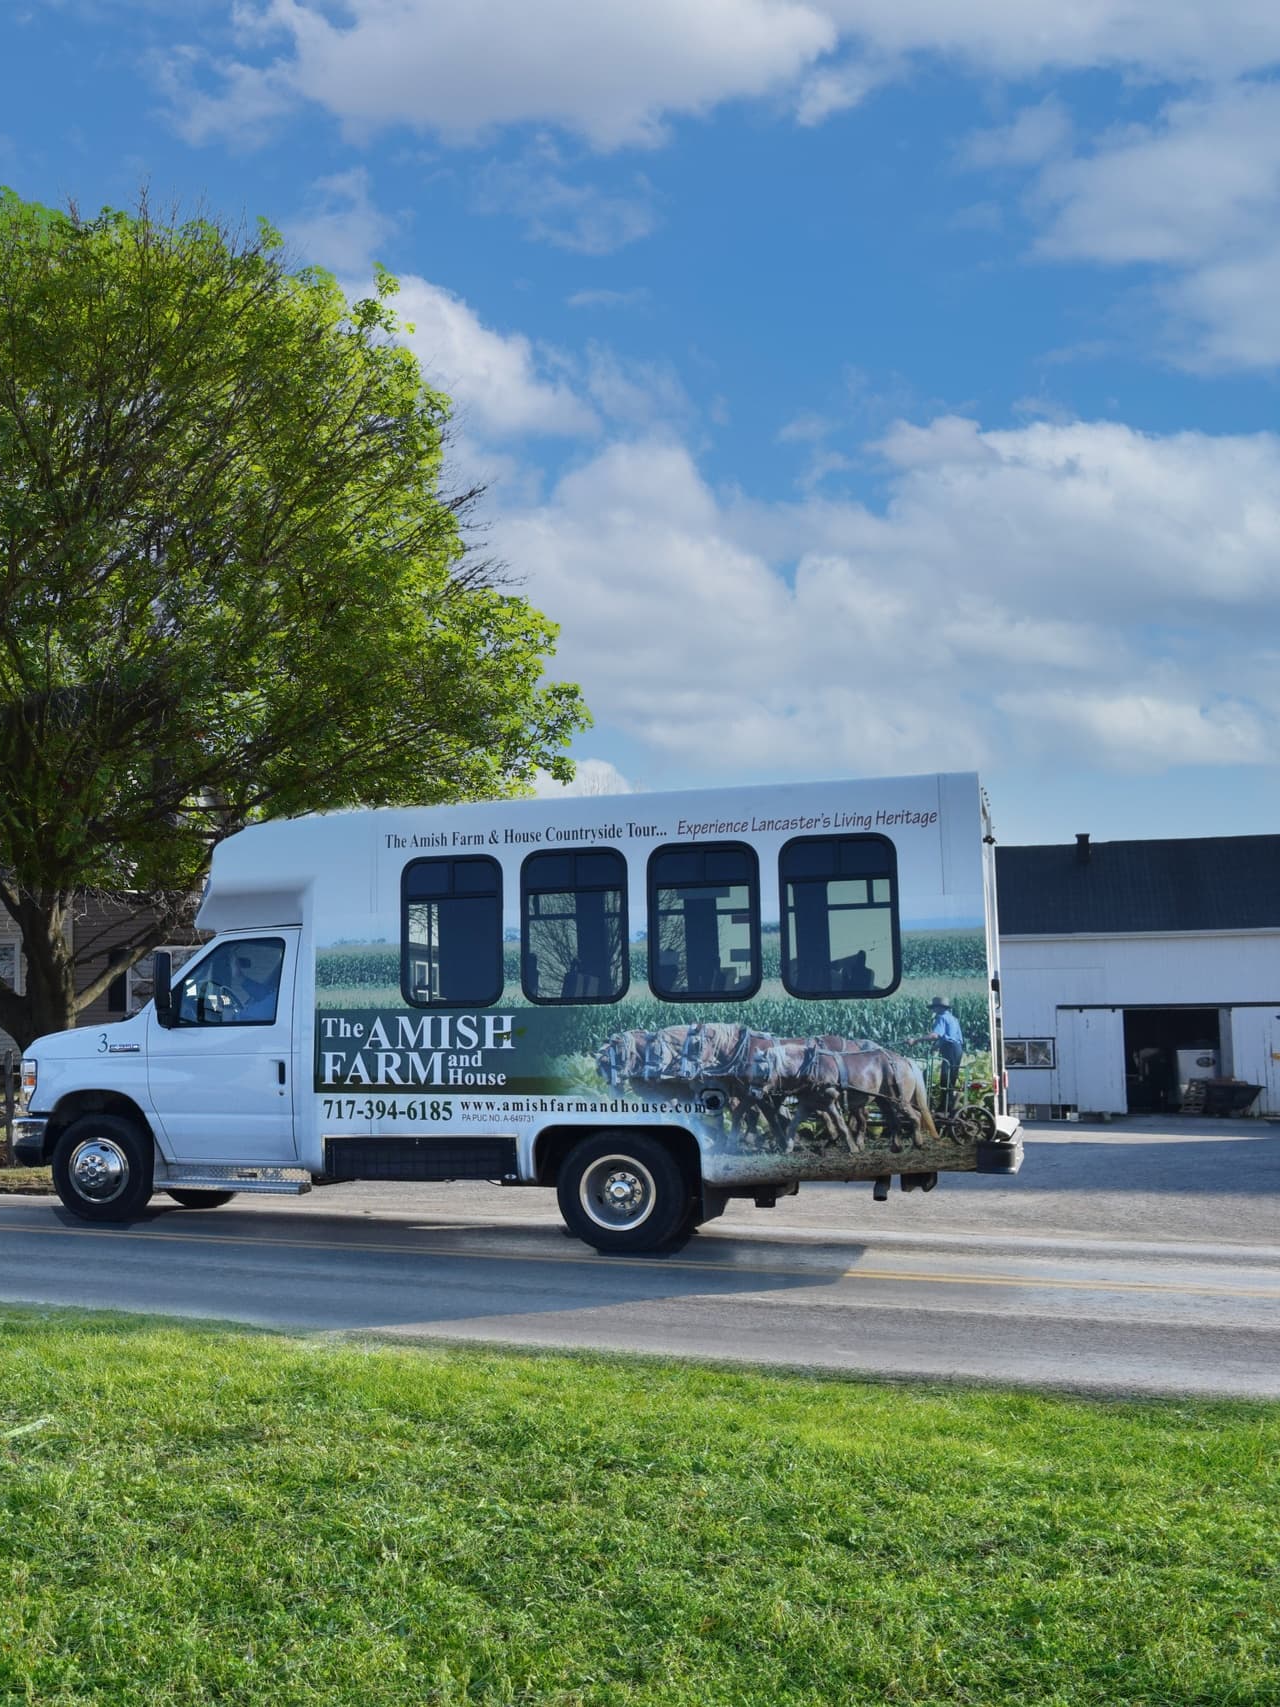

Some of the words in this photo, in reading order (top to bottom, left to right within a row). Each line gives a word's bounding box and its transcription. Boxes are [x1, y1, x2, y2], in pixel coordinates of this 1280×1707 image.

[384, 833, 407, 849] The
[410, 832, 448, 848] Amish
[452, 830, 485, 847] Farm
[488, 829, 500, 845] &
[504, 828, 542, 845] House
[545, 824, 623, 844] Countryside
[626, 822, 668, 839] Tour...
[677, 819, 749, 840] Experience
[751, 813, 831, 832] Lancaster's
[834, 811, 871, 830] Living
[875, 809, 938, 828] Heritage
[97, 1032, 108, 1053] 3
[321, 1017, 365, 1039] The
[363, 1014, 516, 1051] AMISH
[321, 1051, 447, 1086] FARM
[447, 1050, 482, 1068] and
[448, 1068, 507, 1087] House
[322, 1099, 453, 1122] 717-394-6185
[460, 1098, 707, 1114] www.amishfarmandhouse.com
